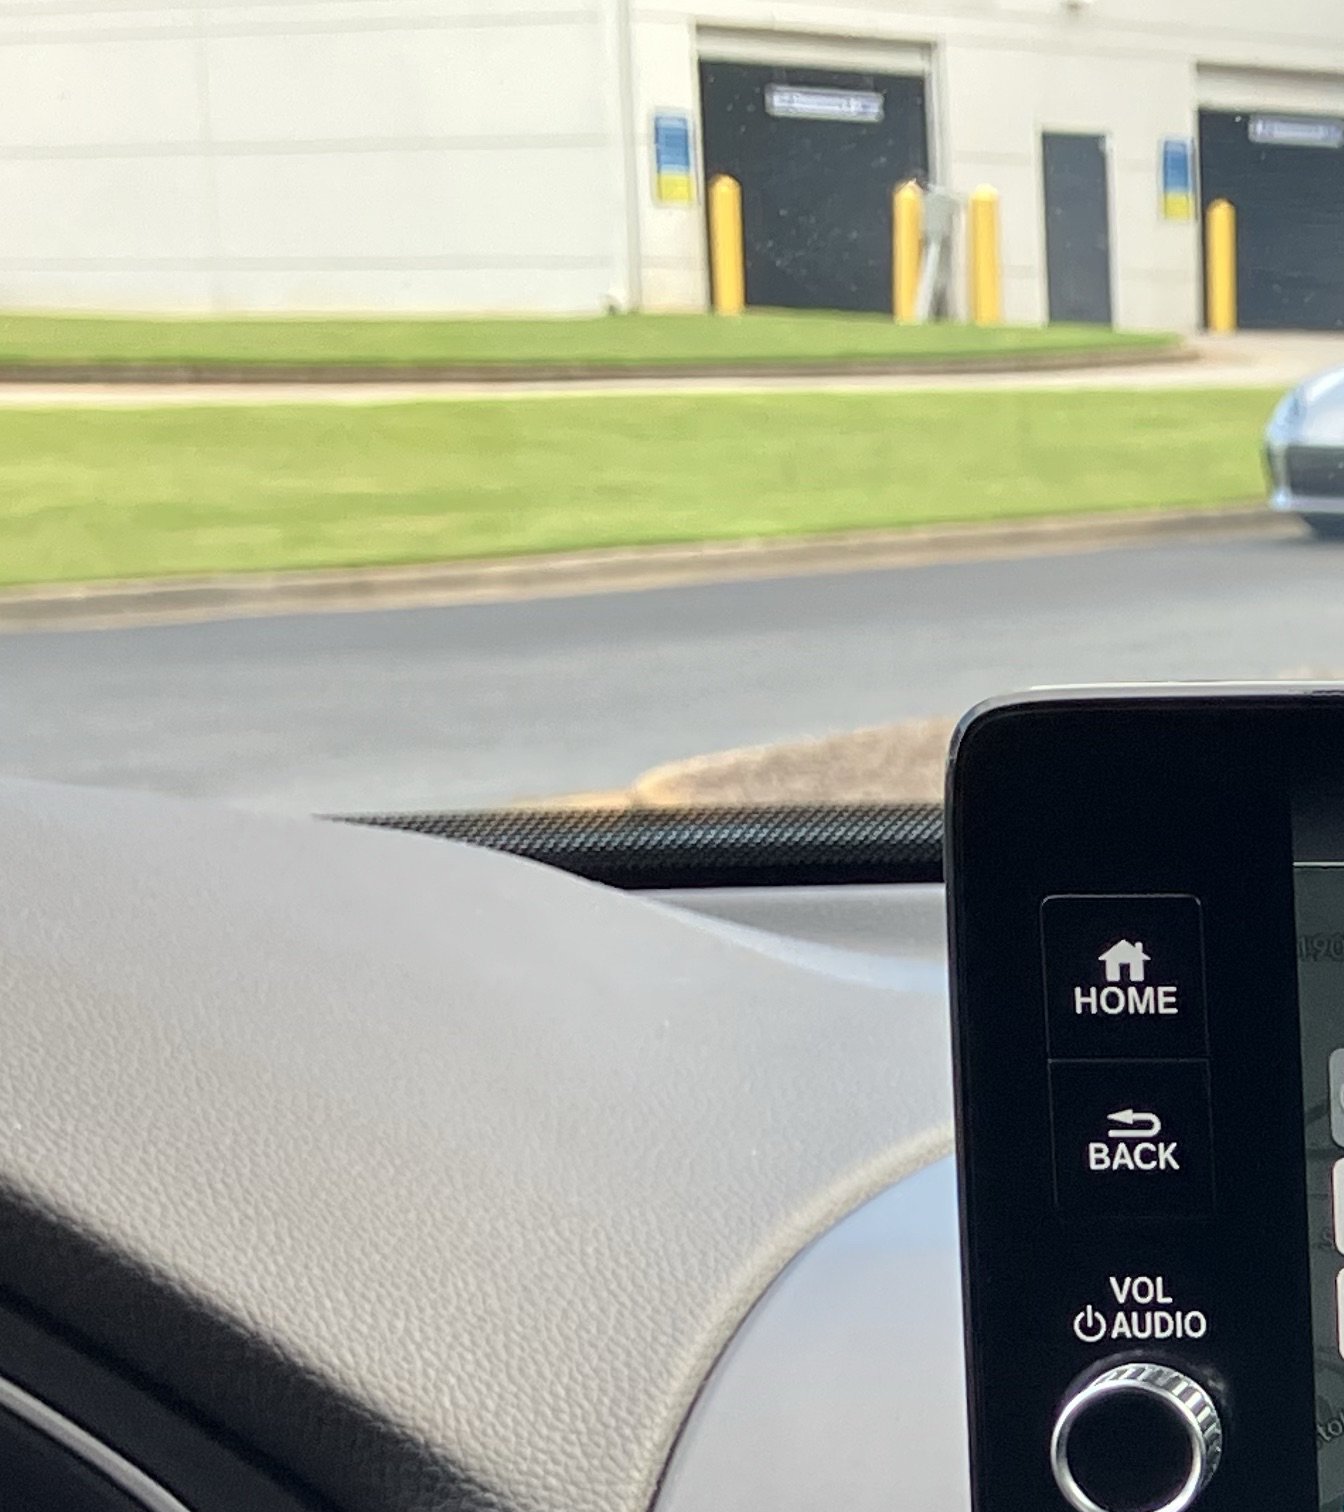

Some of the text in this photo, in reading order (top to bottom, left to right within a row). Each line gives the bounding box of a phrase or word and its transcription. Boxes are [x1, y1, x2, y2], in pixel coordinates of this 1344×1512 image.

[1074, 986, 1179, 1015] HOME
[1088, 1142, 1180, 1171] BACK
[1109, 1276, 1173, 1304] VOL
[1110, 1310, 1207, 1339] AUDIO
